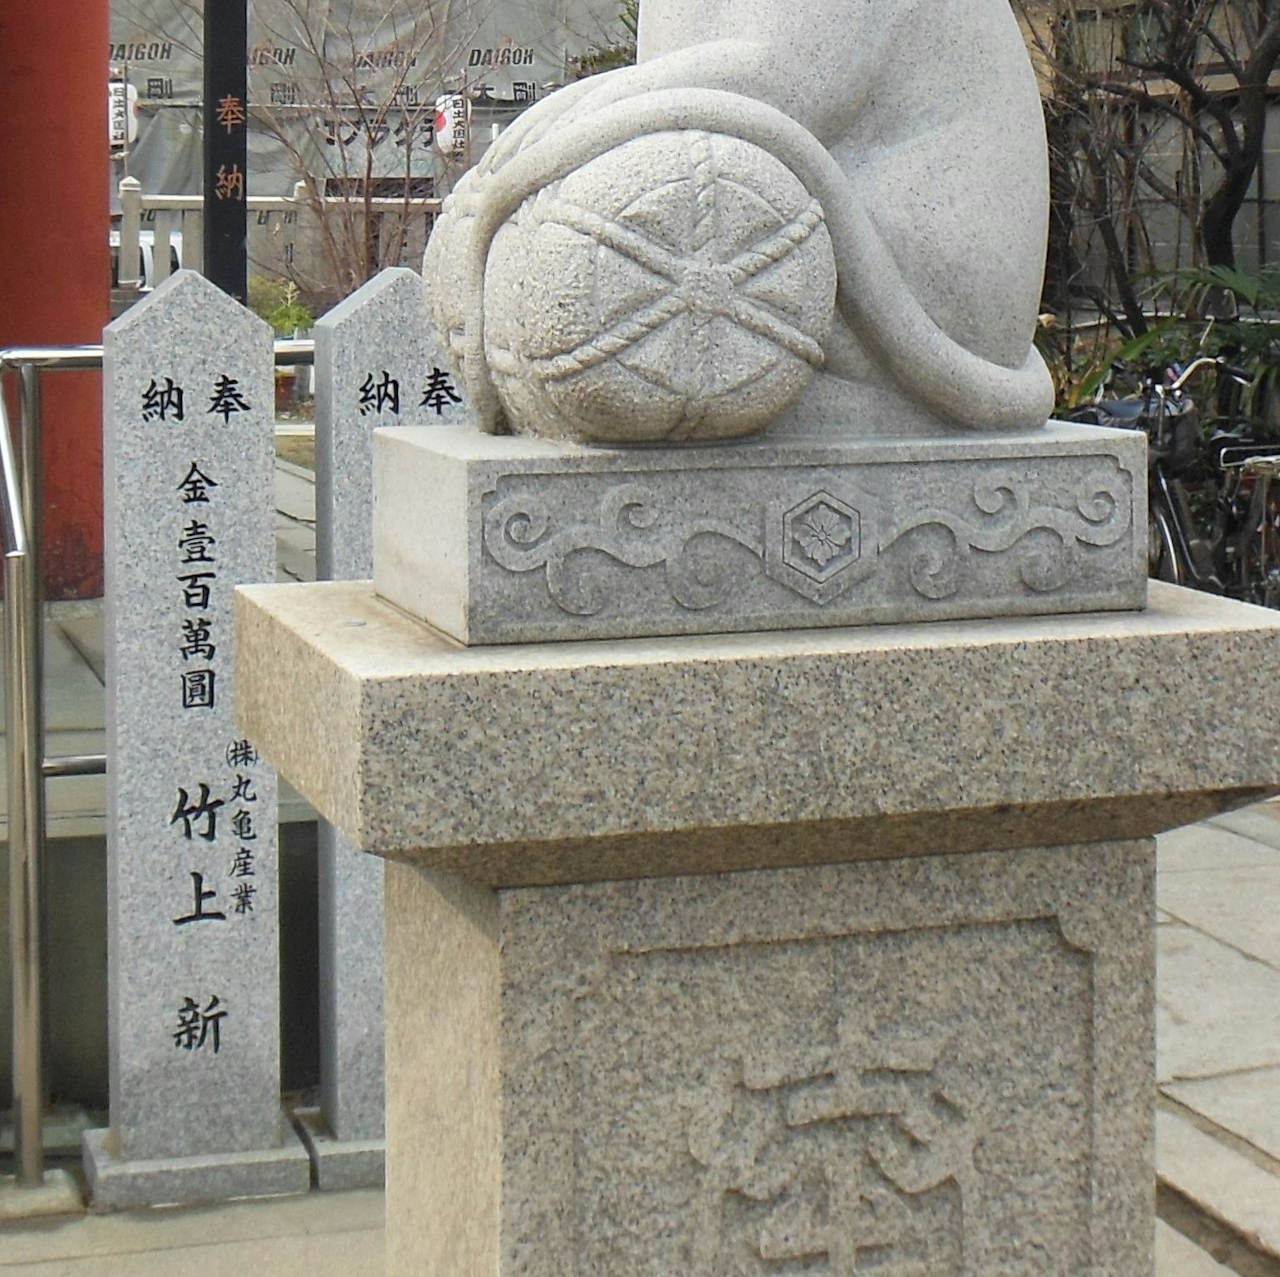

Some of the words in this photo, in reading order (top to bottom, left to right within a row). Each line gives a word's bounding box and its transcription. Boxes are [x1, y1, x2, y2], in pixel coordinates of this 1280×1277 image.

[469, 48, 534, 67] DAIGOH
[215, 93, 245, 200] 奉納
[176, 462, 219, 709] 金壹百萬圓
